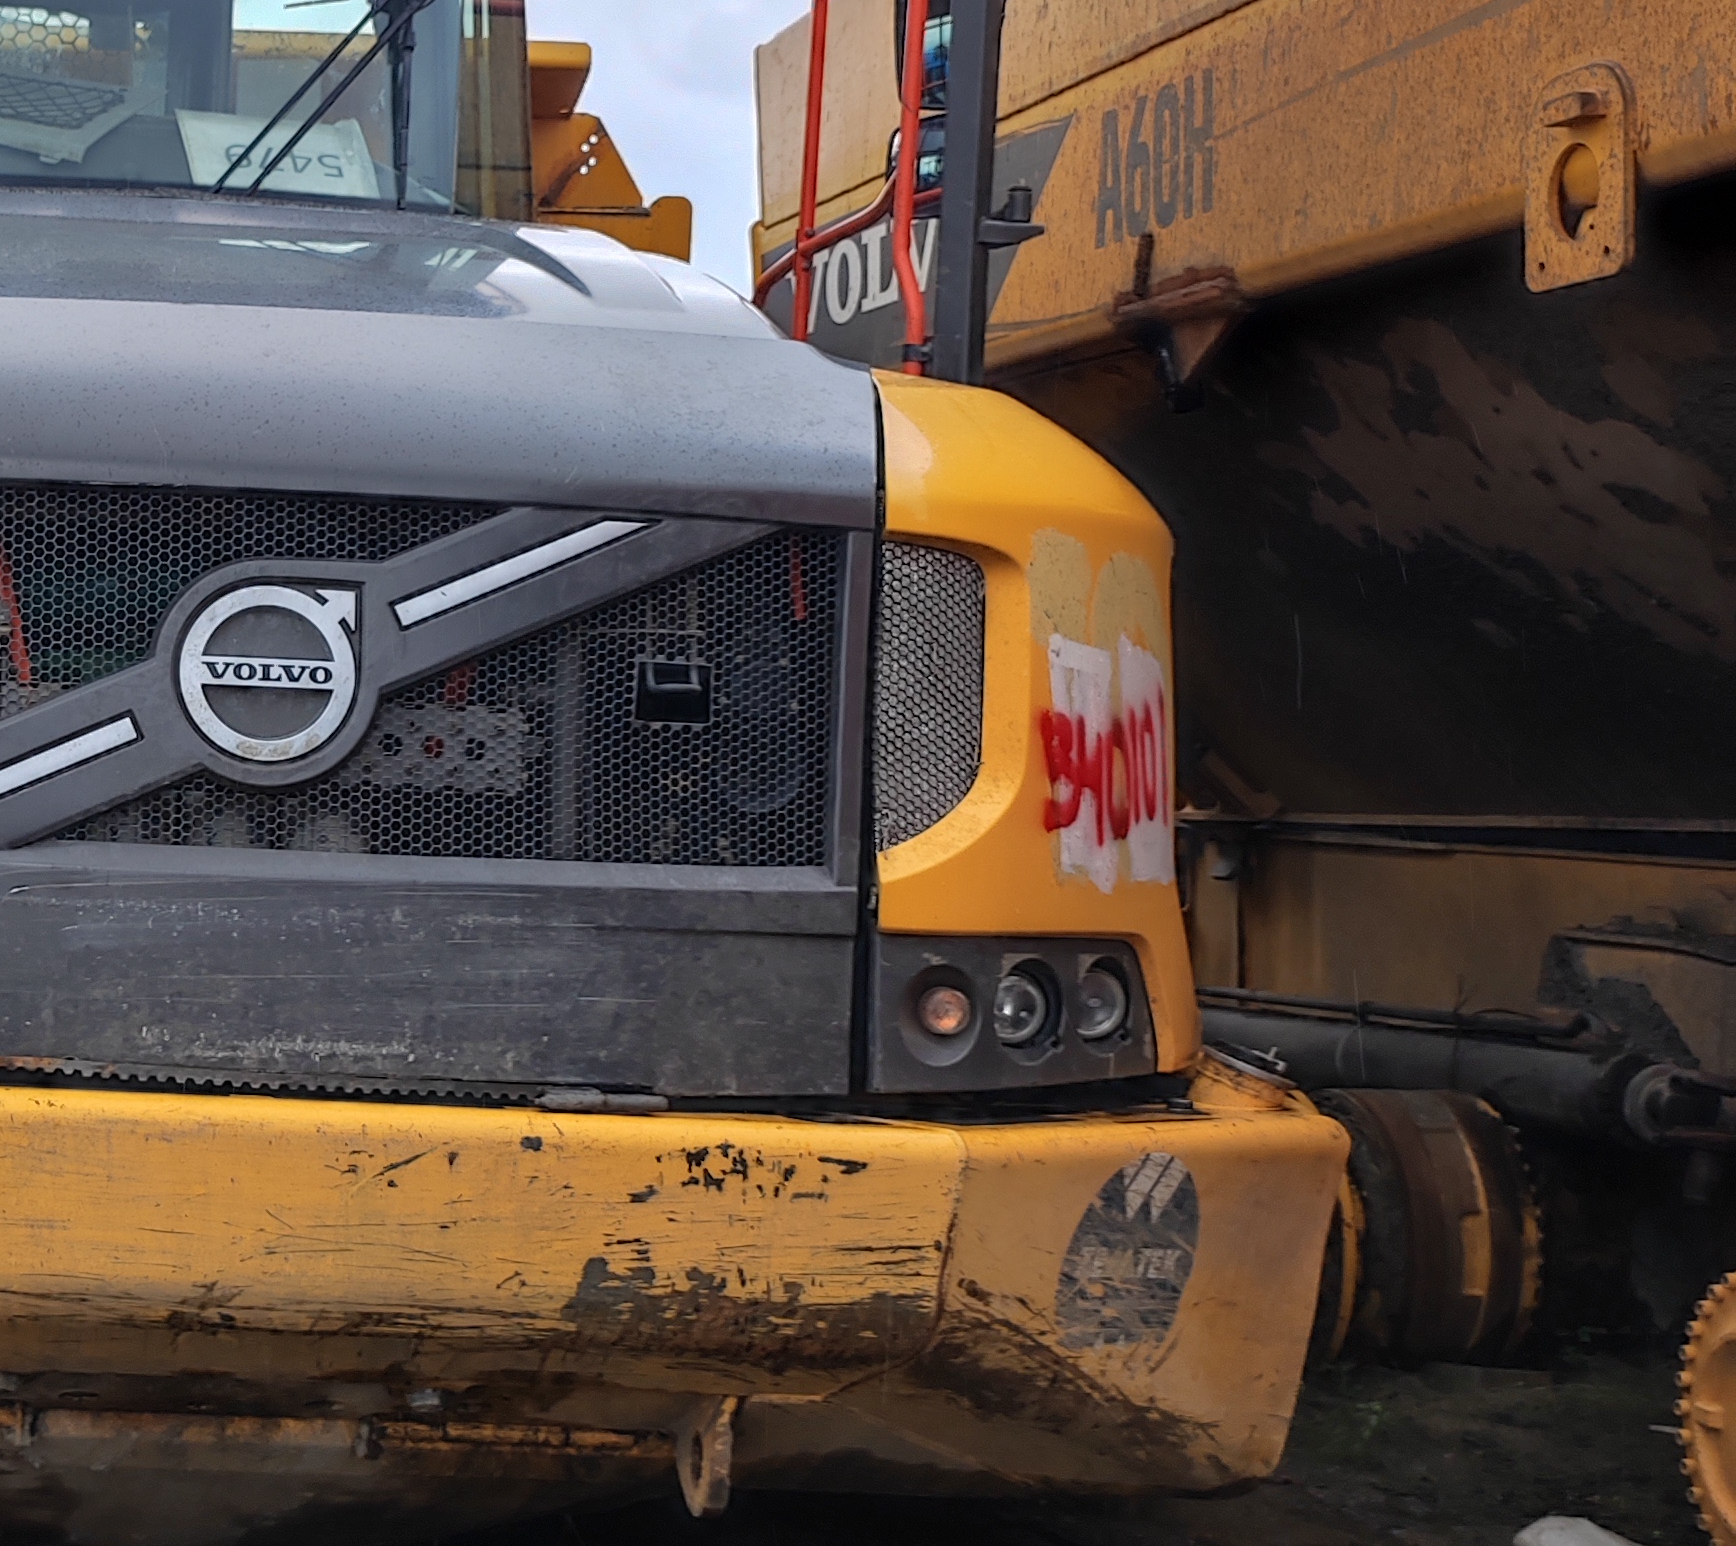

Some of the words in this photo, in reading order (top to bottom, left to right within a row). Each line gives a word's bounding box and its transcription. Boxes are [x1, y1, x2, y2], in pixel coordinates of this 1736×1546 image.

[1095, 68, 1214, 249] A60H
[785, 217, 940, 335] VOLV
[201, 660, 333, 684] VOLVO
